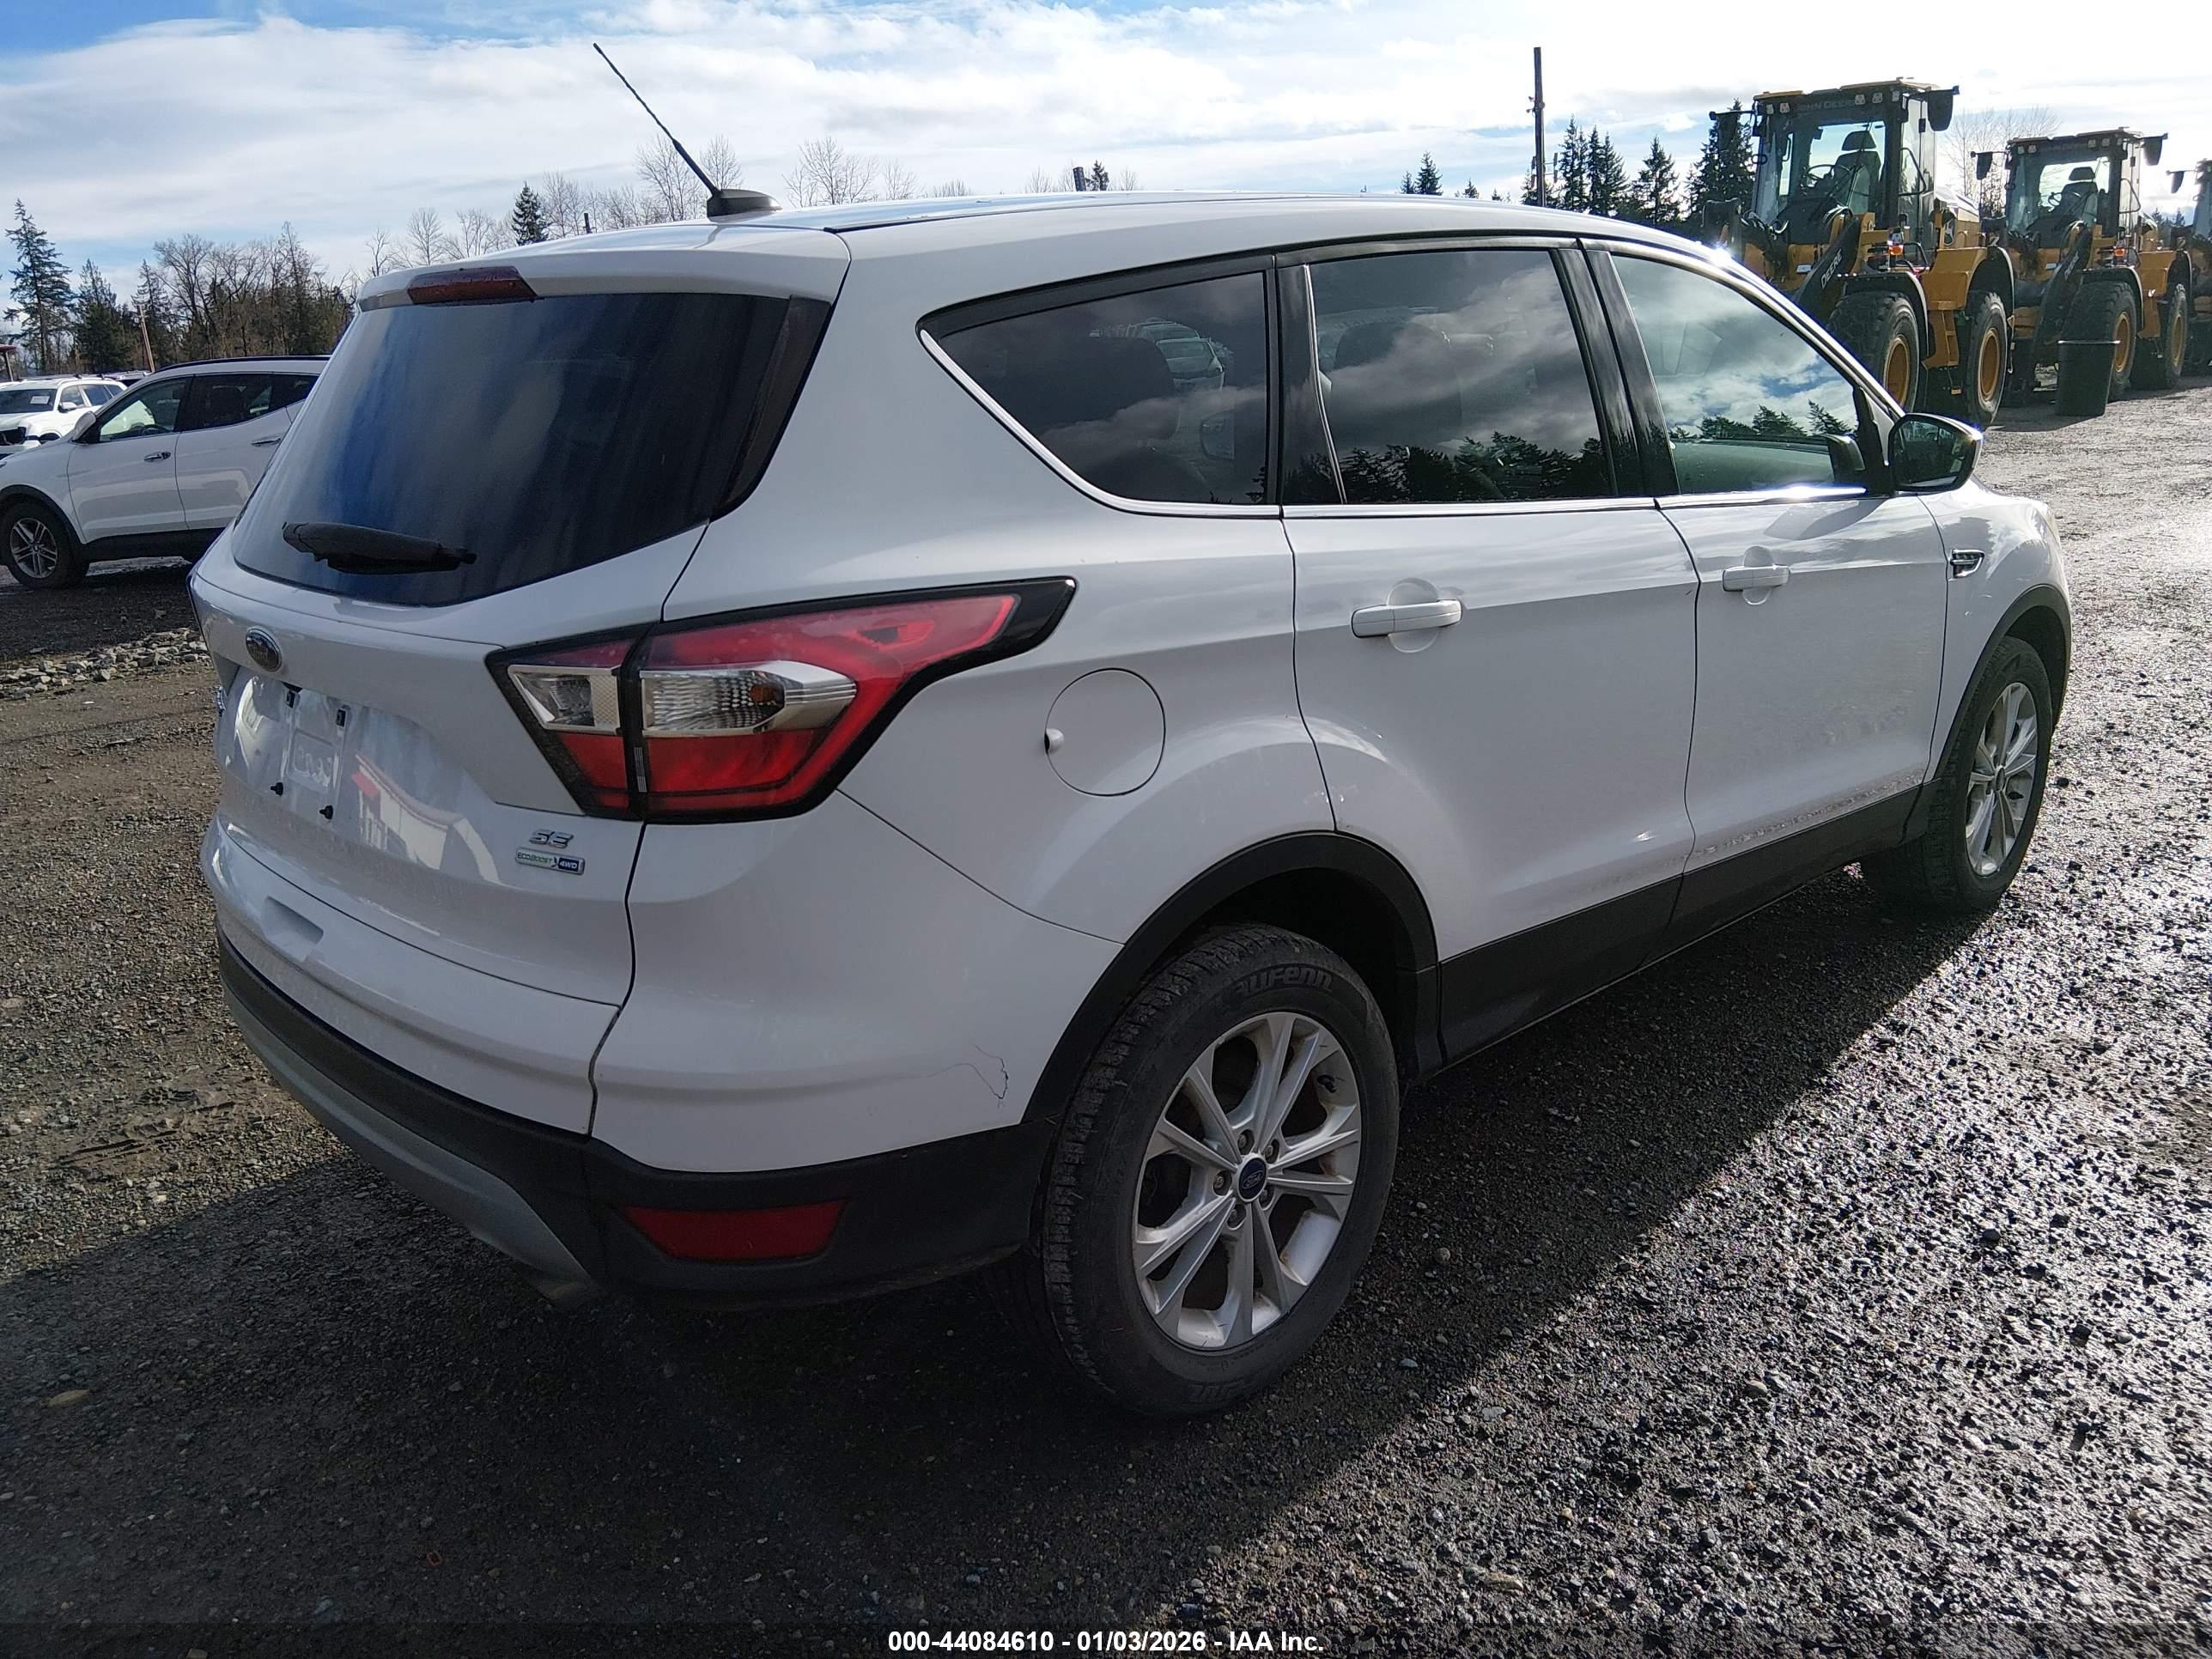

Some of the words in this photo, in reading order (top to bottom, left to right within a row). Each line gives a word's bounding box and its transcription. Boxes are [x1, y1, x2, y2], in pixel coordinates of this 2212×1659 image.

[1821, 248, 1842, 289] DEERE
[529, 829, 574, 849] SE
[559, 860, 578, 870] 4WD
